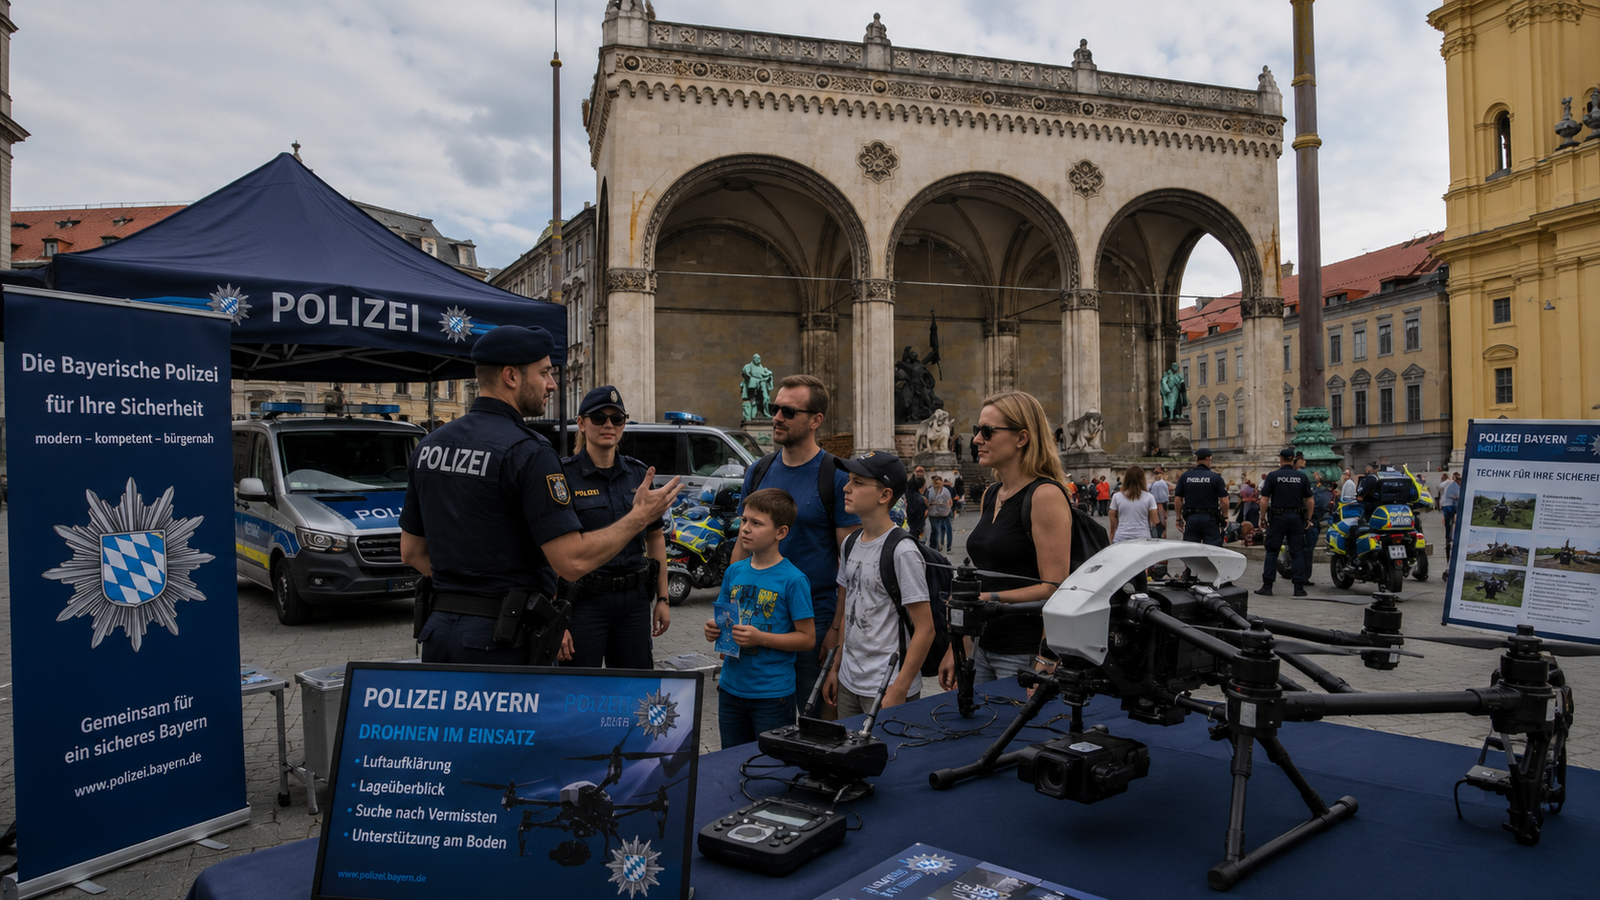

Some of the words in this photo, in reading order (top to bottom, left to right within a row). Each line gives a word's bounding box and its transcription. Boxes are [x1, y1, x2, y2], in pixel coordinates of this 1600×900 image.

[272, 292, 419, 333] POLIZEI
[22, 353, 55, 372] Die
[62, 356, 160, 379] Bayerische
[166, 363, 218, 382] Polizei
[46, 394, 74, 413] für
[80, 396, 116, 414] Ihre
[121, 398, 204, 416] Sicherheit
[36, 432, 82, 444] modern
[95, 432, 152, 446] kompetent
[164, 433, 214, 446] bürgernah
[1479, 433, 1521, 444] POLIZEI
[1524, 434, 1568, 444] BAYERN
[417, 446, 491, 477] POLIZEI
[1476, 468, 1512, 478] TECHNK
[1514, 468, 1530, 479] FÜR
[1533, 472, 1554, 480] IHRE
[364, 687, 447, 710] POLIZEI
[454, 690, 540, 712] BAYERN
[81, 702, 170, 733] Gemeinsam
[174, 695, 194, 710] für
[64, 746, 90, 764] ein
[94, 730, 156, 756] sicheres
[160, 716, 208, 739] Bayern
[358, 724, 439, 742] DROHNEN
[443, 727, 464, 742] IM
[468, 728, 536, 746] EINSATZ
[74, 752, 202, 797] www.polizei.bayern.de
[363, 755, 452, 774] Luftaufklärung
[359, 779, 446, 796] Lageüberblick
[356, 804, 392, 818] Suche
[396, 806, 425, 820] nach
[429, 807, 498, 824] Vermissten
[352, 828, 440, 849] Unterstützung
[443, 836, 463, 847] am
[466, 834, 507, 850] Boden
[338, 870, 426, 883] www.polizei.bayern.de
